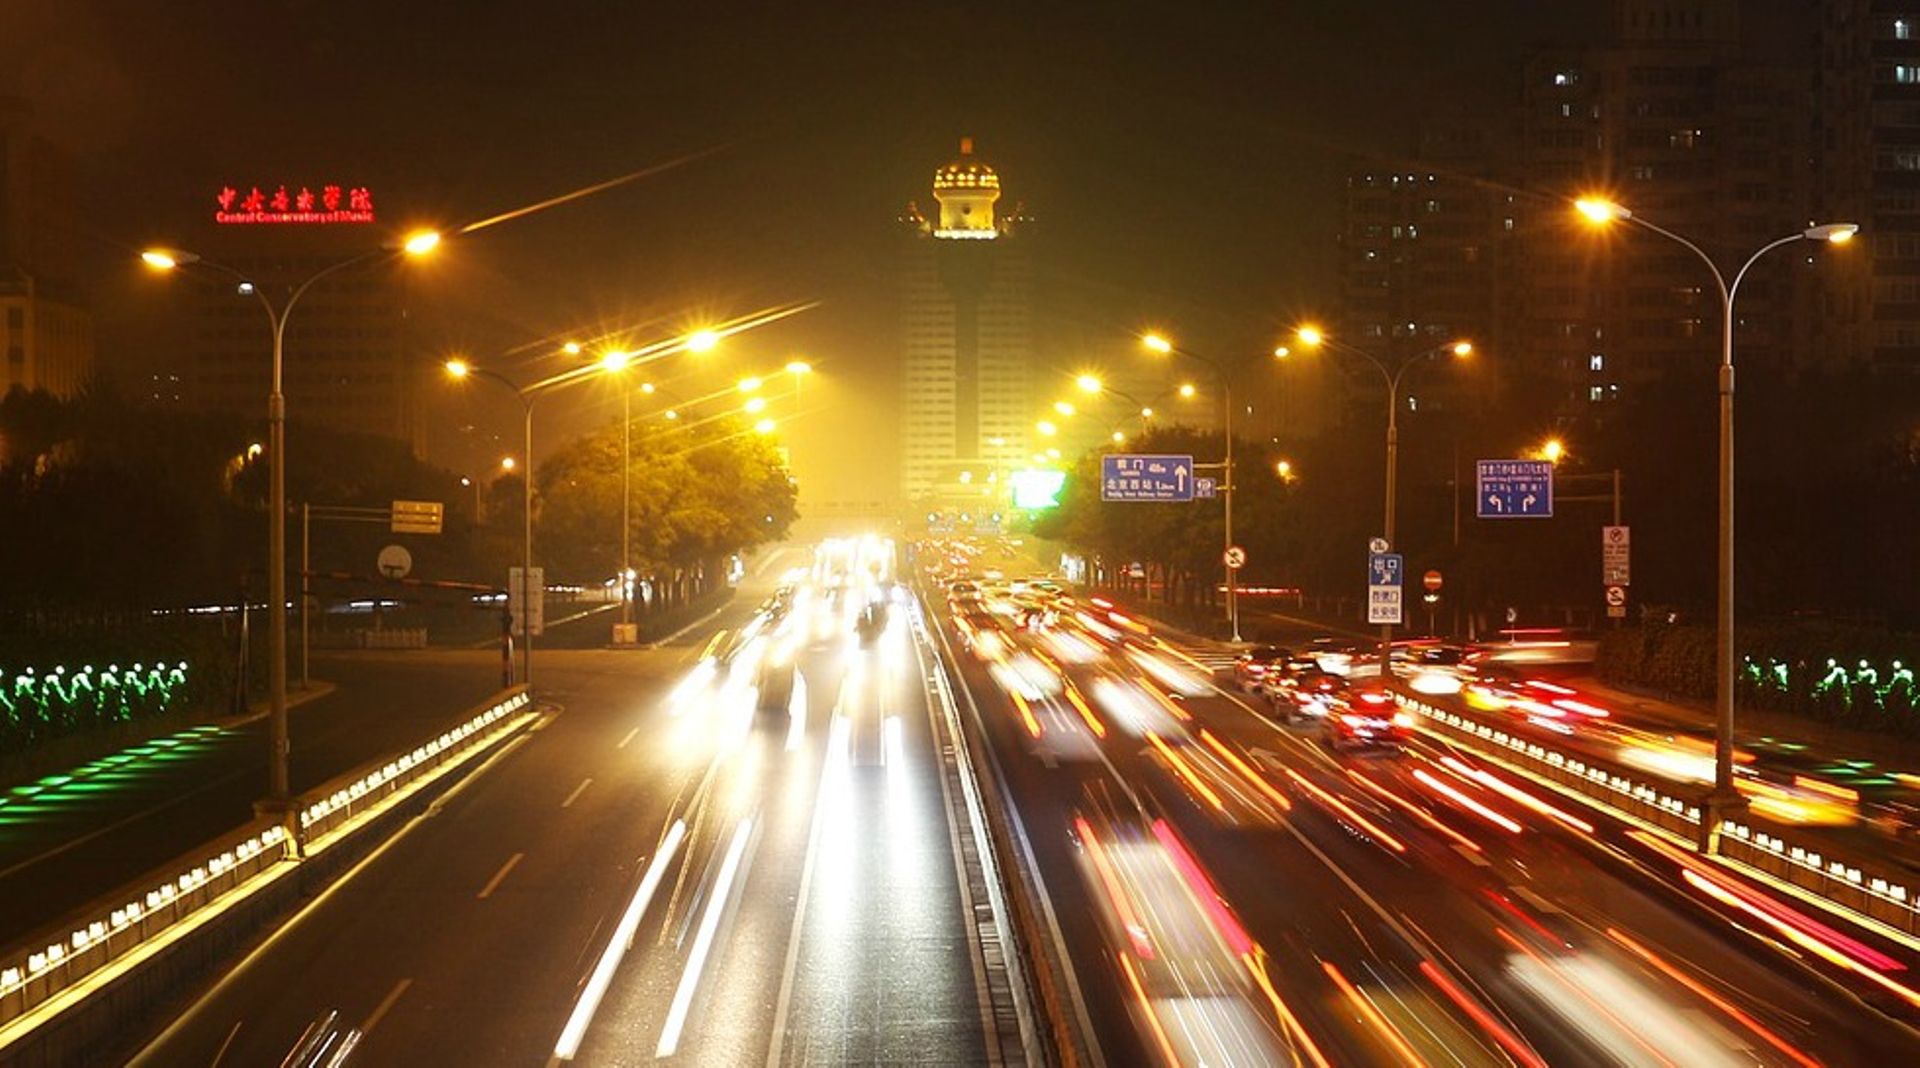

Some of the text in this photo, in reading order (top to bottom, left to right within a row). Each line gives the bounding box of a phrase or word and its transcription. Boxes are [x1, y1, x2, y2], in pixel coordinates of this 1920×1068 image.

[217, 184, 372, 210] 中央音乐学院
[216, 211, 255, 223] Central
[256, 211, 325, 223] Conservatory
[340, 211, 373, 222] Music
[1107, 479, 1152, 490] 北京西站
[1374, 558, 1397, 570] 出口
